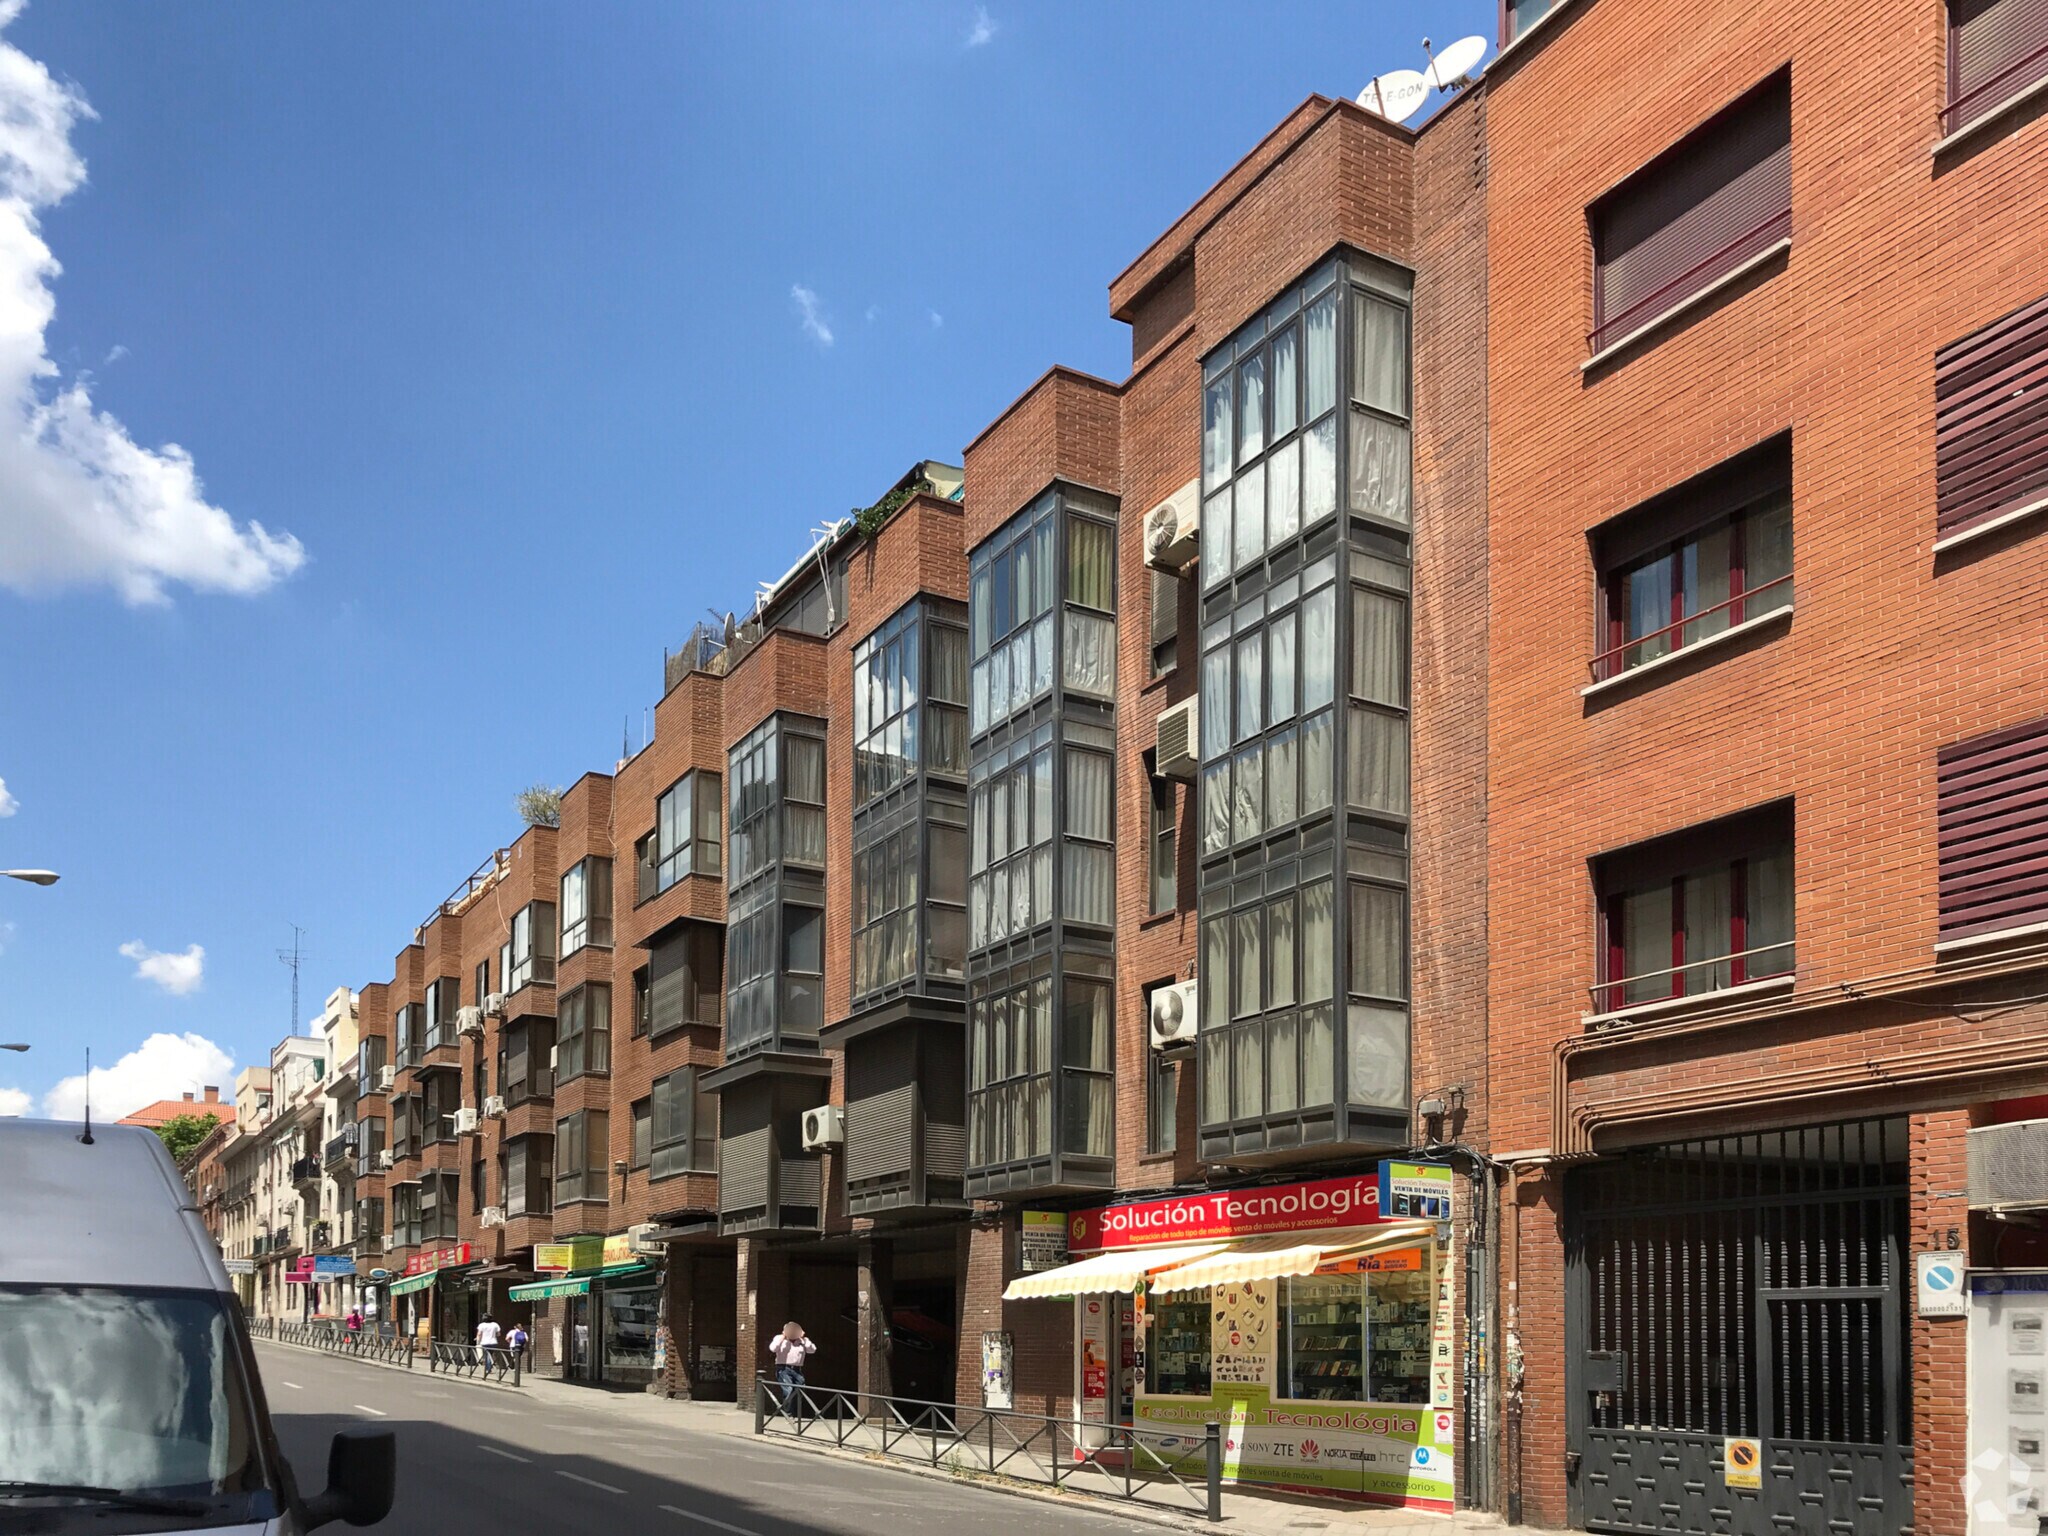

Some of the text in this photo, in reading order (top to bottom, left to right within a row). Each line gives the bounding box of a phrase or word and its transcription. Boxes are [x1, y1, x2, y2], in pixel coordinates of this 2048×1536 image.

[1363, 81, 1423, 104] TEE-GON
[1099, 1181, 1380, 1232] Solución Tecnología
[1129, 1231, 1161, 1242] Reparación
[1161, 1231, 1169, 1239] de
[1170, 1230, 1185, 1238] todo
[1185, 1229, 1198, 1238] tipo
[1198, 1227, 1207, 1235] de
[1207, 1225, 1233, 1235] móviles
[1253, 1222, 1263, 1231] de
[1263, 1220, 1290, 1230] móviles
[1297, 1217, 1338, 1227] accessorios
[1932, 1227, 1961, 1251] 15
[1262, 1409, 1418, 1434] Tecnológia
[1247, 1443, 1270, 1452] SONY
[1273, 1443, 1294, 1457] ZTE
[1323, 1449, 1348, 1459] NOKIA
[1186, 1461, 1203, 1470] todo
[1229, 1464, 1256, 1475] móviles
[1258, 1469, 1280, 1477] venta
[1281, 1468, 1292, 1478] de
[1294, 1470, 1323, 1481] móviles
[1372, 1479, 1378, 1487] y
[1379, 1479, 1436, 1492] accessorios
